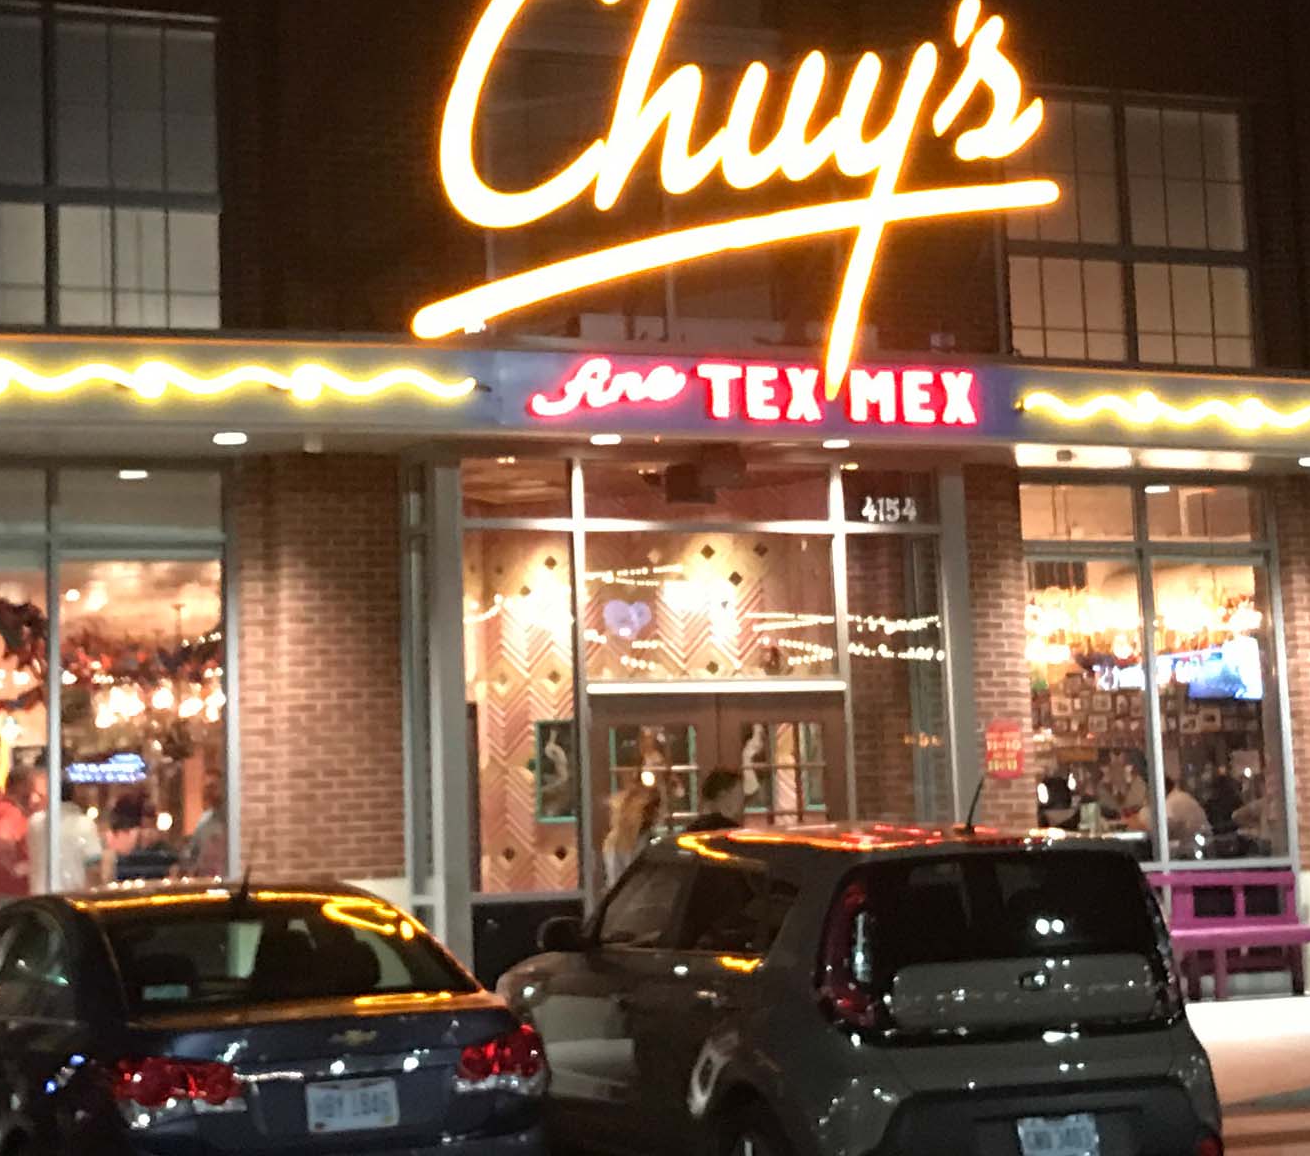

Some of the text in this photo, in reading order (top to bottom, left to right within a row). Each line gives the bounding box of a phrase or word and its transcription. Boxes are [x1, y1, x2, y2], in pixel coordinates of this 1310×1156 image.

[696, 363, 824, 422] TEX
[849, 369, 978, 425] MEX
[861, 495, 918, 523] 4154
